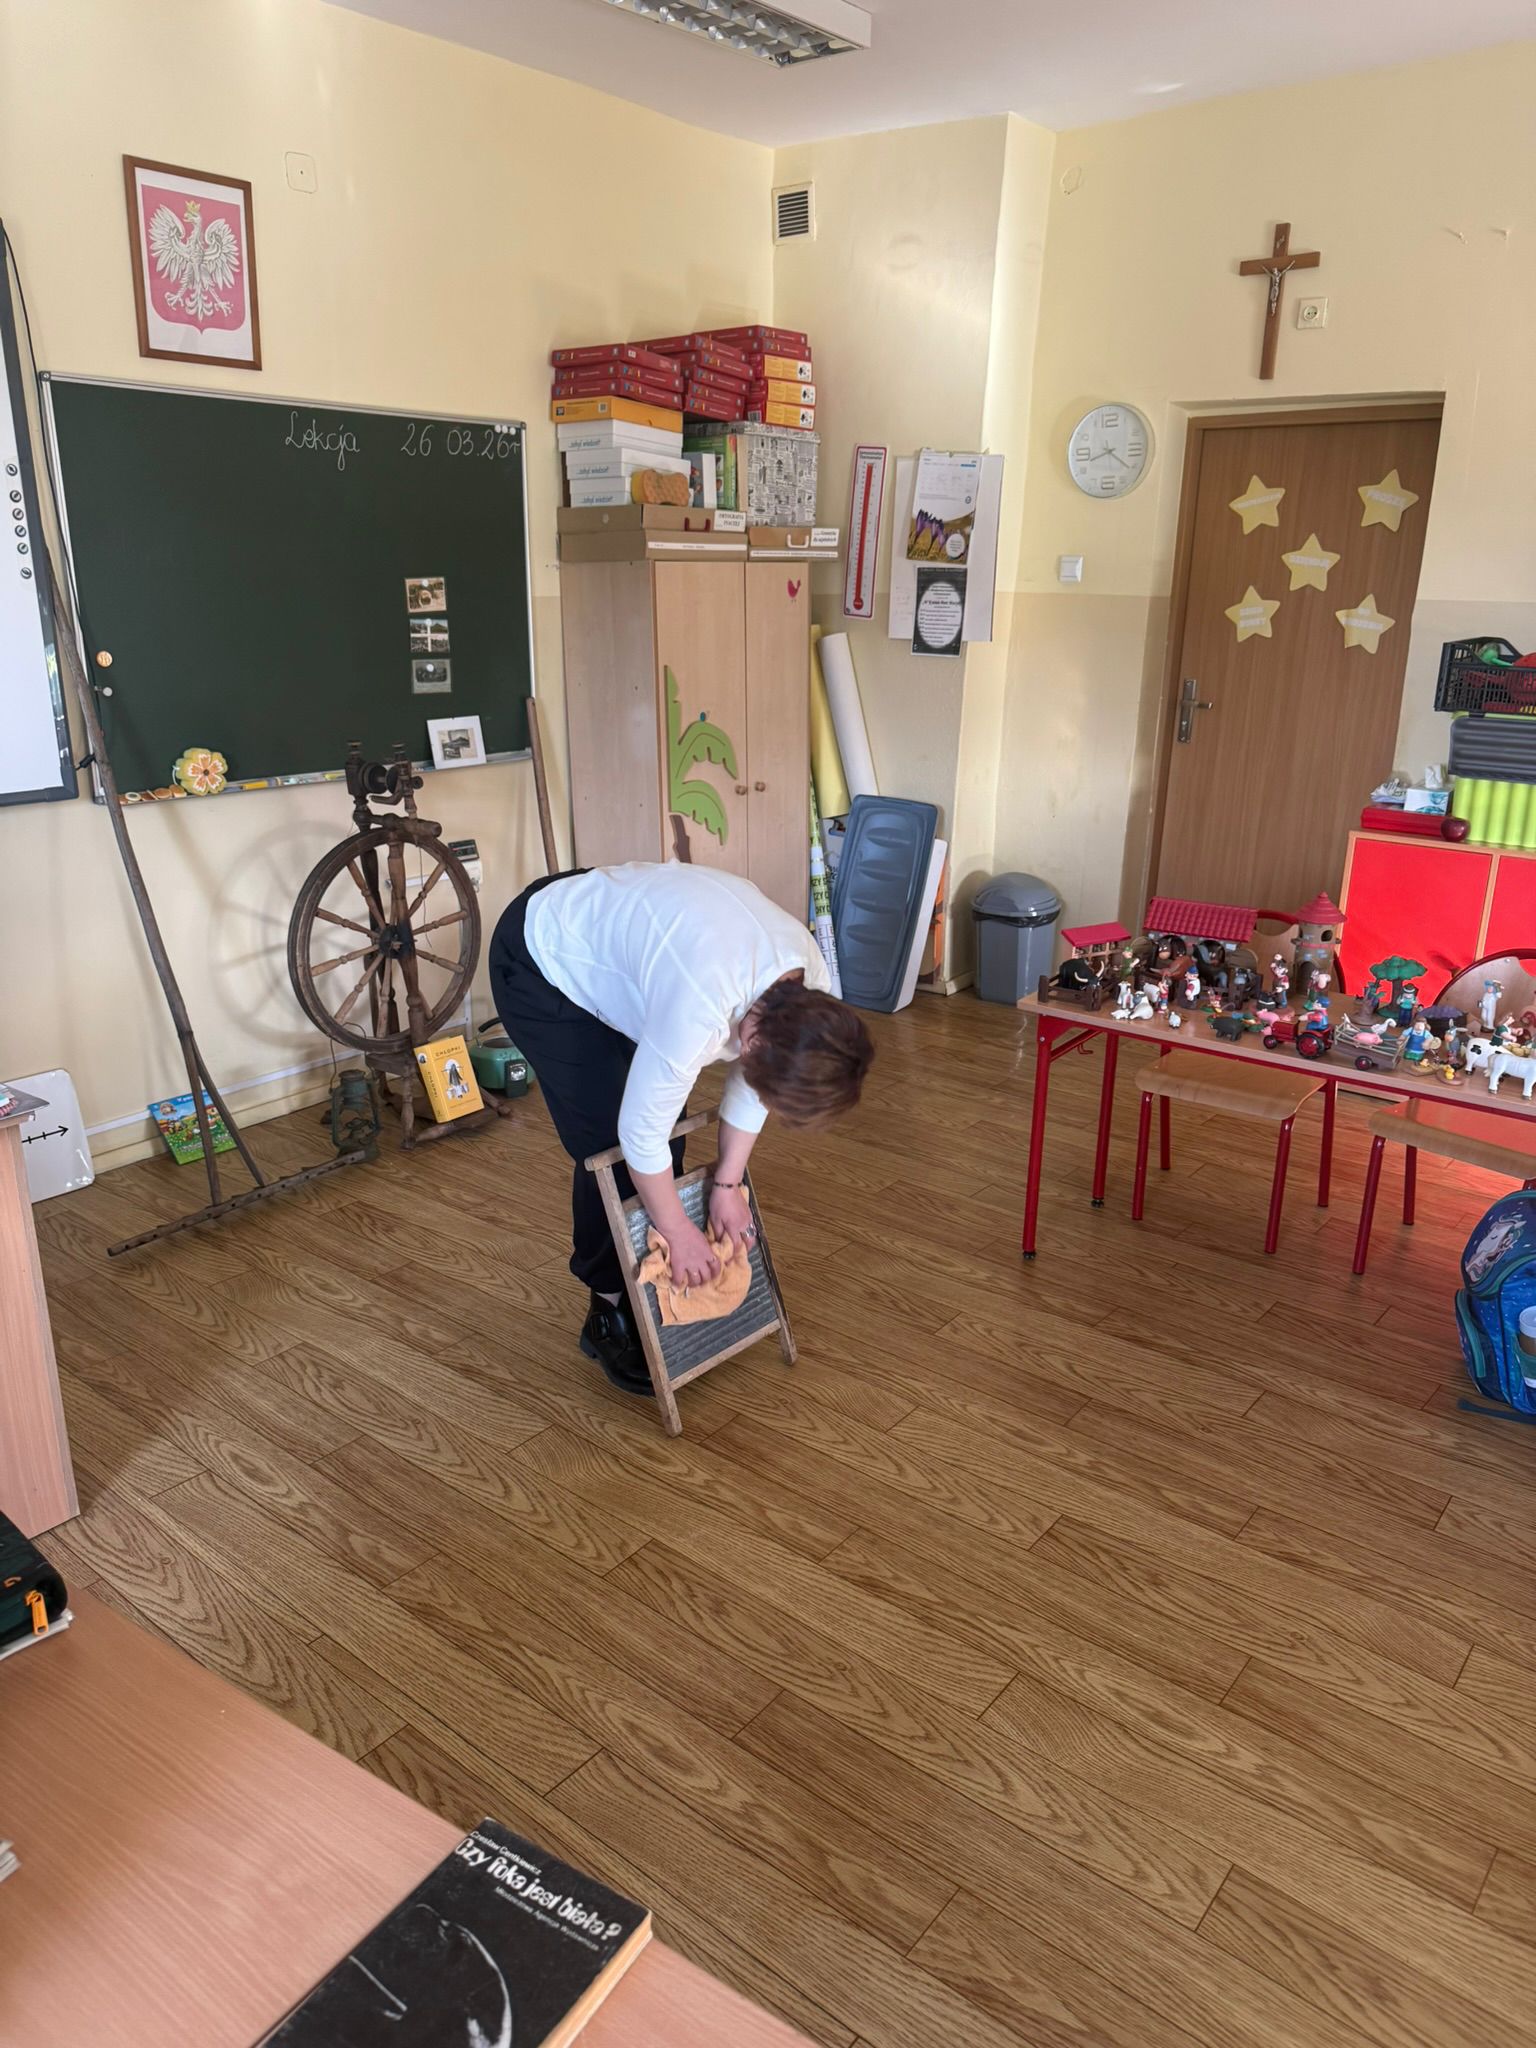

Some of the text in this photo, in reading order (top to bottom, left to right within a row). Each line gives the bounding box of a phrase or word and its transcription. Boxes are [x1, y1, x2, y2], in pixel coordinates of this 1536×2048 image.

[285, 410, 360, 471] Lekcja
[400, 422, 434, 456] 26
[470, 1830, 542, 1875] Czesław Centkiewicz
[454, 1837, 622, 1941] Czy foka jest biała?
